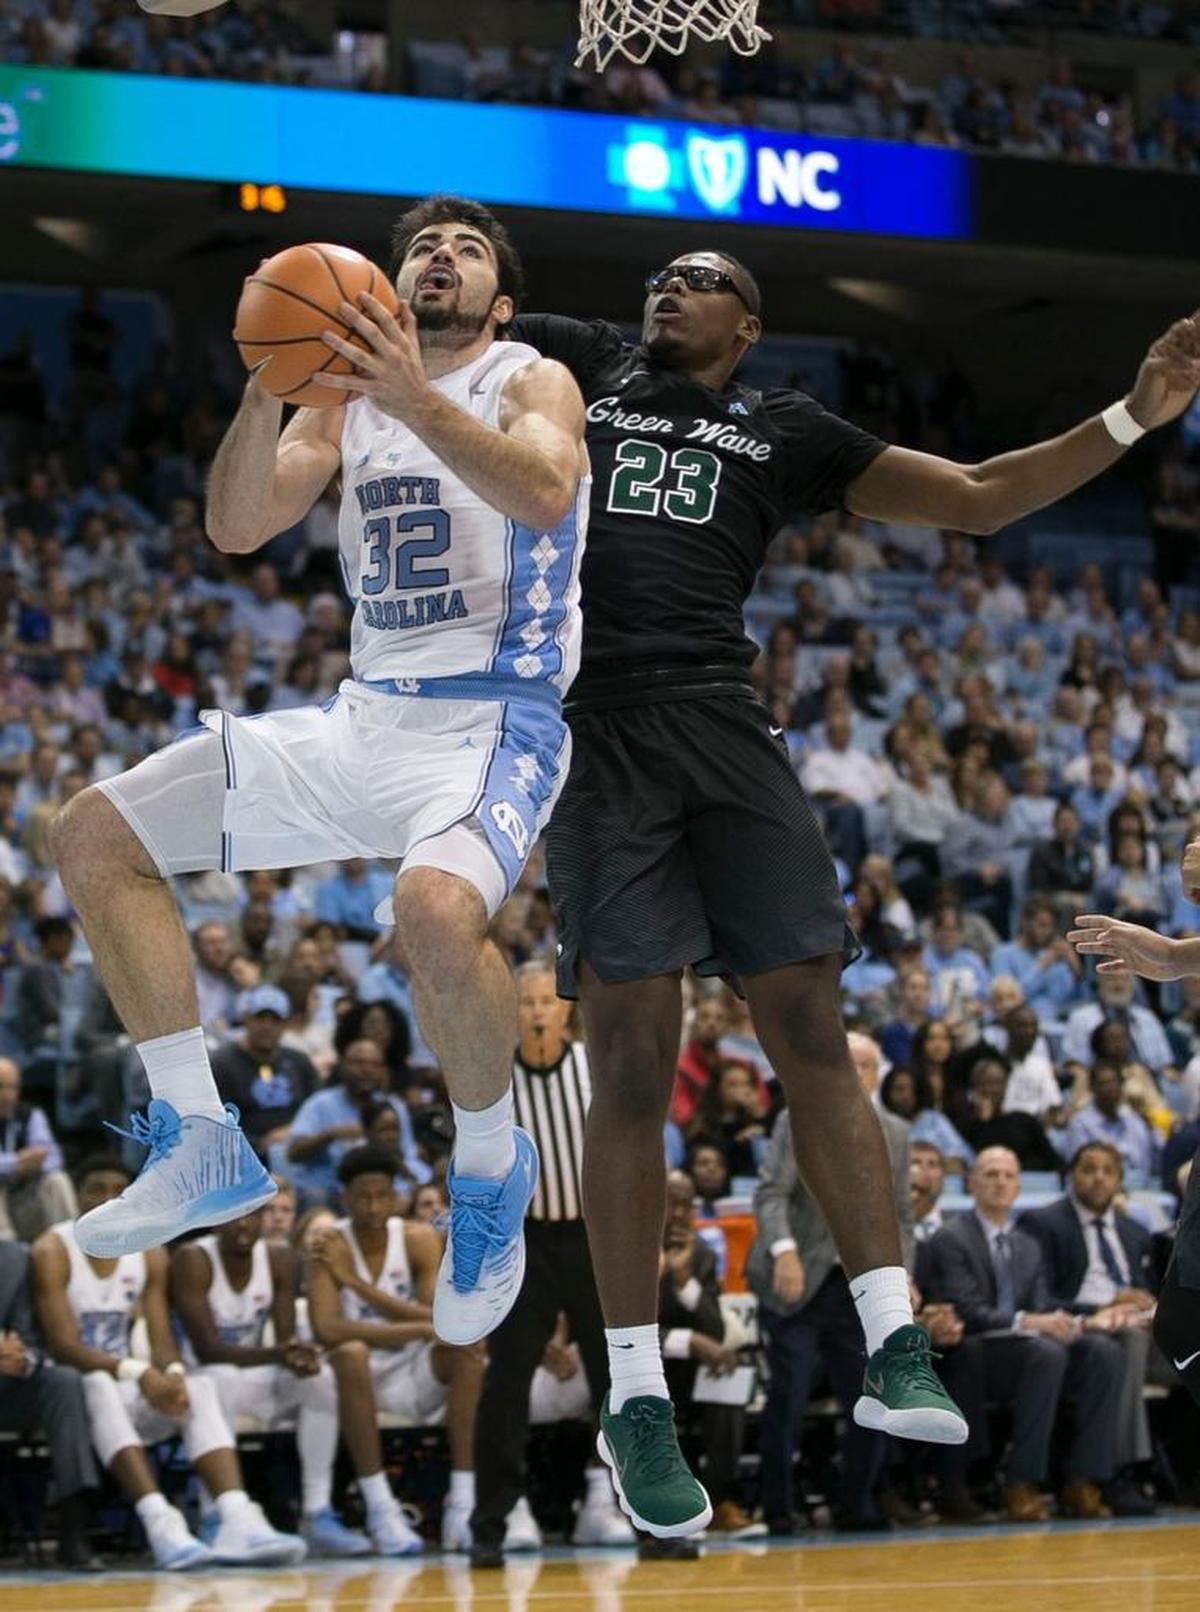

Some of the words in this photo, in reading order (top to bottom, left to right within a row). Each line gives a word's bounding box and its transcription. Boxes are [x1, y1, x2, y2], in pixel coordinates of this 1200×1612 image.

[757, 147, 841, 211] NC
[586, 397, 674, 433] Green
[685, 418, 771, 461] Wave
[607, 438, 722, 525] 23
[362, 509, 451, 595] 32
